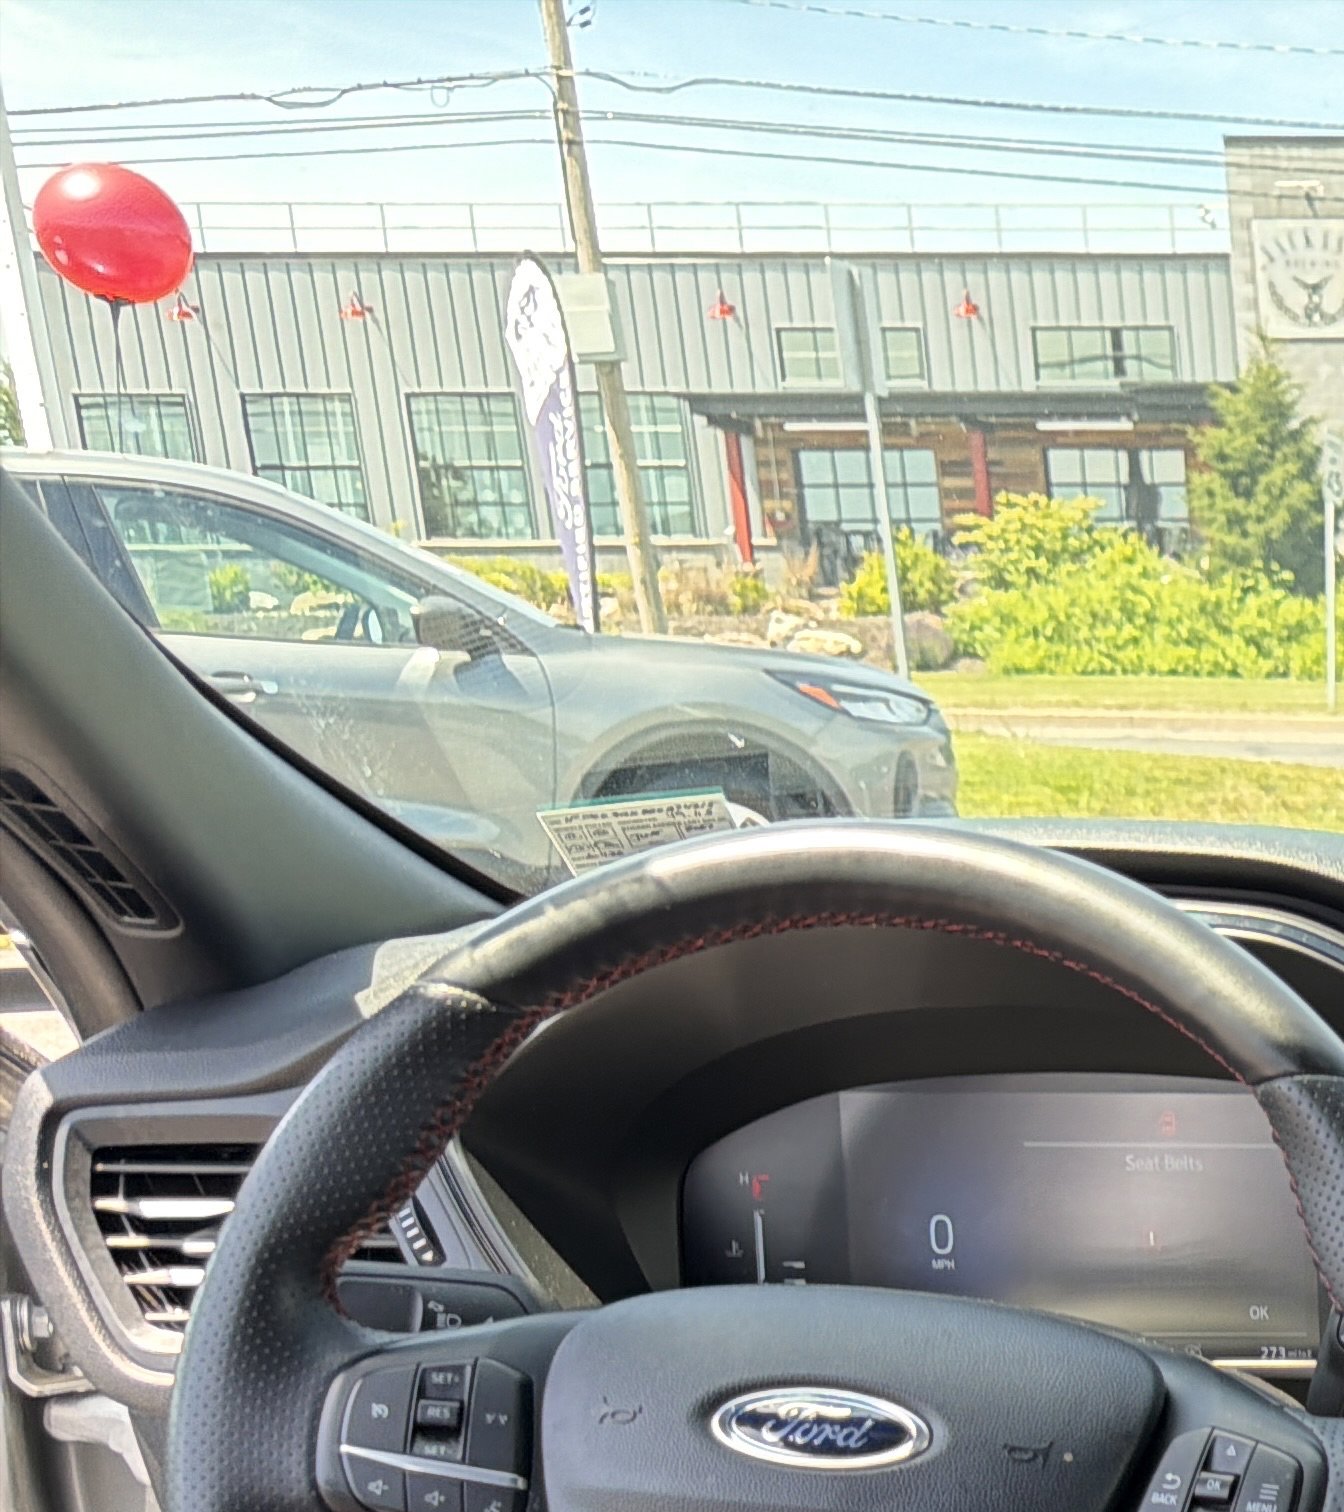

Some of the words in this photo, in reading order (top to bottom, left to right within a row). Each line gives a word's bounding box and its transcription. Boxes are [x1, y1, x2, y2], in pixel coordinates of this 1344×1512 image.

[1124, 1154, 1161, 1172] Seat
[1164, 1154, 1205, 1171] Belts
[739, 1171, 749, 1185] H
[928, 1214, 954, 1255] 0
[931, 1258, 955, 1271] MPH
[1249, 1305, 1270, 1320] OK
[1260, 1347, 1286, 1360] 273
[426, 1406, 450, 1419] RES
[760, 1401, 876, 1450] Ford
[1206, 1479, 1221, 1491] OK
[1151, 1491, 1178, 1506] BACK
